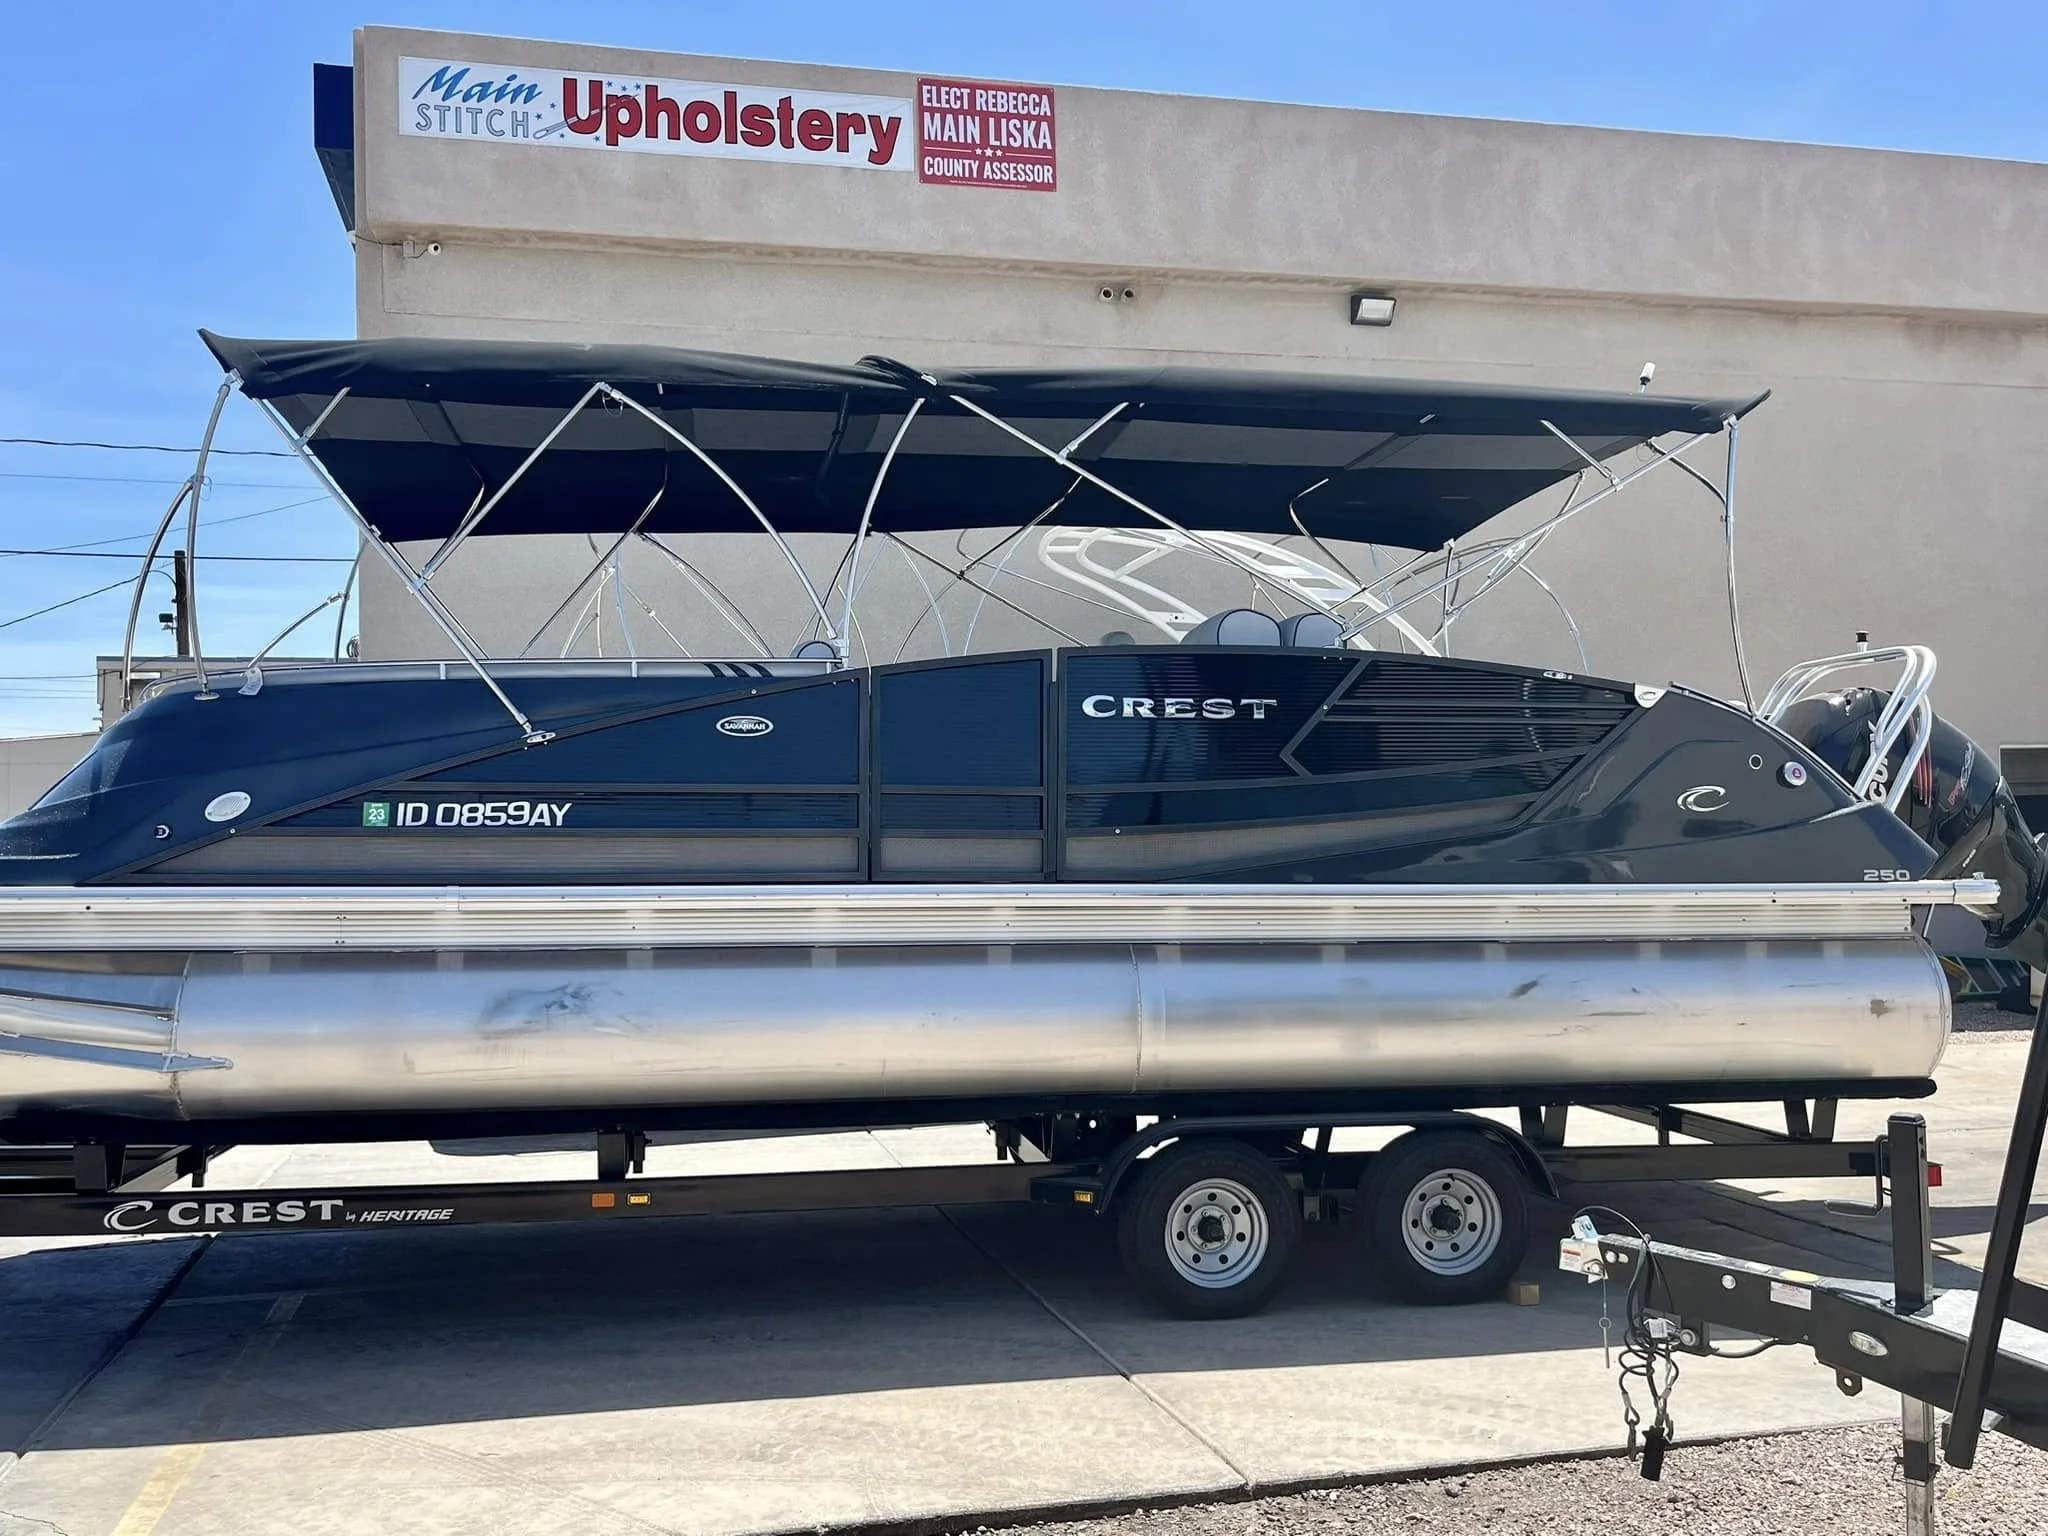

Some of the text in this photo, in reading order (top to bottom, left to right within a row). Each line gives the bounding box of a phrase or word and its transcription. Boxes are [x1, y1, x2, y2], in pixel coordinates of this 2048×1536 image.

[412, 65, 542, 105] Main
[922, 85, 1051, 117] ELECT REBECCA
[415, 103, 529, 138] STITCH
[562, 77, 902, 165] Upholstery
[923, 111, 1052, 150] MAIN LISKA
[924, 156, 1054, 184] COUNTY ASSESSOR
[1082, 694, 1278, 720] CREST
[723, 722, 766, 730] SAVANNAH
[367, 808, 386, 821] 23
[396, 801, 573, 826] ID 0859AY
[1863, 869, 1910, 881] 250
[167, 1199, 344, 1226] CREST
[359, 1207, 456, 1223] HERITAGE
